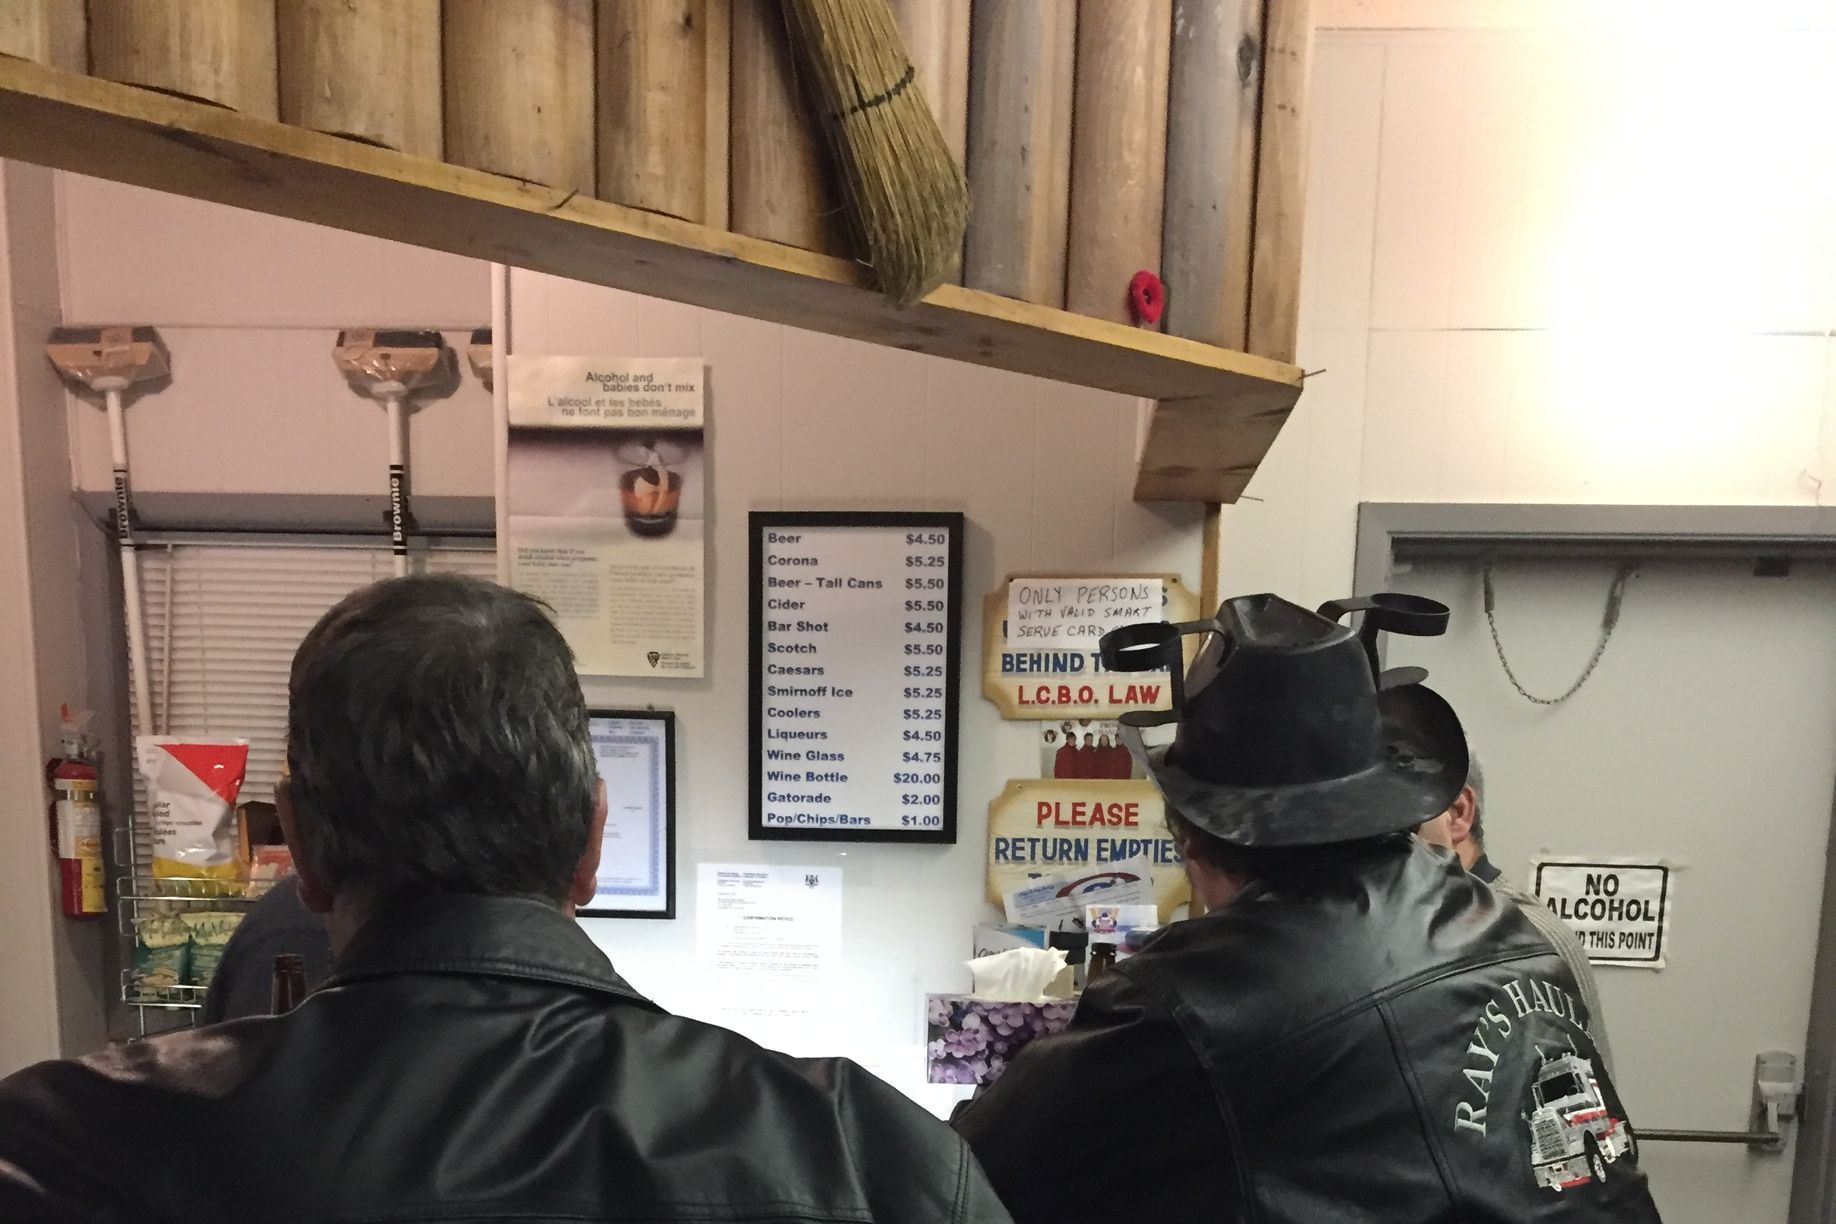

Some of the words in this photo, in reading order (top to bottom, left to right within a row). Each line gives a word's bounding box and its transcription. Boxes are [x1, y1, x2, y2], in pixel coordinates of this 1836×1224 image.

[585, 372, 629, 383] Alcohol
[632, 373, 653, 383] and
[603, 382, 639, 392] babies
[643, 382, 672, 392] don't
[675, 383, 695, 392] mix
[562, 407, 576, 416] ne
[578, 406, 600, 417] font
[604, 408, 624, 420] pas
[627, 407, 649, 417] bon
[391, 477, 403, 542] Brownie
[768, 533, 802, 545] Beer
[905, 534, 946, 546] $4.50
[767, 555, 819, 567] Corona
[905, 555, 945, 568] $5.25
[768, 577, 802, 589] Beer
[816, 577, 843, 589] Tall
[847, 577, 883, 590] Cans
[905, 578, 945, 590] $5.50
[1018, 586, 1062, 605] ONLY
[1077, 583, 1150, 604] PERSONS
[767, 598, 806, 611] Cider
[904, 600, 944, 612] $5.50
[1018, 608, 1052, 620] WITH
[1060, 605, 1096, 619] VALID
[1103, 606, 1153, 619] SMART
[767, 621, 792, 633] Bar
[796, 621, 829, 633] Shot
[904, 622, 944, 634] $4.50
[1016, 625, 1061, 638] SERVE
[1066, 624, 1105, 637] CARD
[767, 642, 817, 654] Scotch
[904, 644, 944, 656] $5.50
[1001, 653, 1085, 673] BEHIND
[767, 664, 825, 676] Caesars
[904, 665, 943, 678] $5.25
[767, 685, 828, 697] Smirnoff
[831, 686, 854, 698] Ice
[903, 687, 943, 699] $5.25
[1018, 685, 1099, 705] L.C.B.O.
[1108, 685, 1161, 705] LAW
[767, 707, 821, 719] Coolers
[903, 708, 942, 721] $5.25
[767, 728, 828, 742] Liqueurs
[903, 730, 942, 742] $4.50
[767, 749, 801, 762] Wine
[805, 749, 845, 762] Glass
[902, 751, 941, 764] $4.75
[767, 771, 801, 783] Wine
[805, 771, 848, 783] Bottle
[893, 772, 941, 785] $20.00
[767, 792, 832, 804] Gatorade
[901, 794, 940, 806] $2.00
[767, 813, 871, 826] Pop/Chips/Bars
[901, 815, 940, 827] $1.00
[1037, 801, 1139, 826] PLEASE
[994, 837, 1089, 862] RETURN
[1096, 838, 1184, 863] EMPTIES
[1585, 873, 1620, 897] NO
[1546, 897, 1656, 922] ALCOHOL
[1589, 931, 1616, 949] THIS
[1618, 932, 1655, 950] POINT
[1453, 999, 1513, 1138] RAY'S
[1502, 978, 1592, 1036] HAUL
